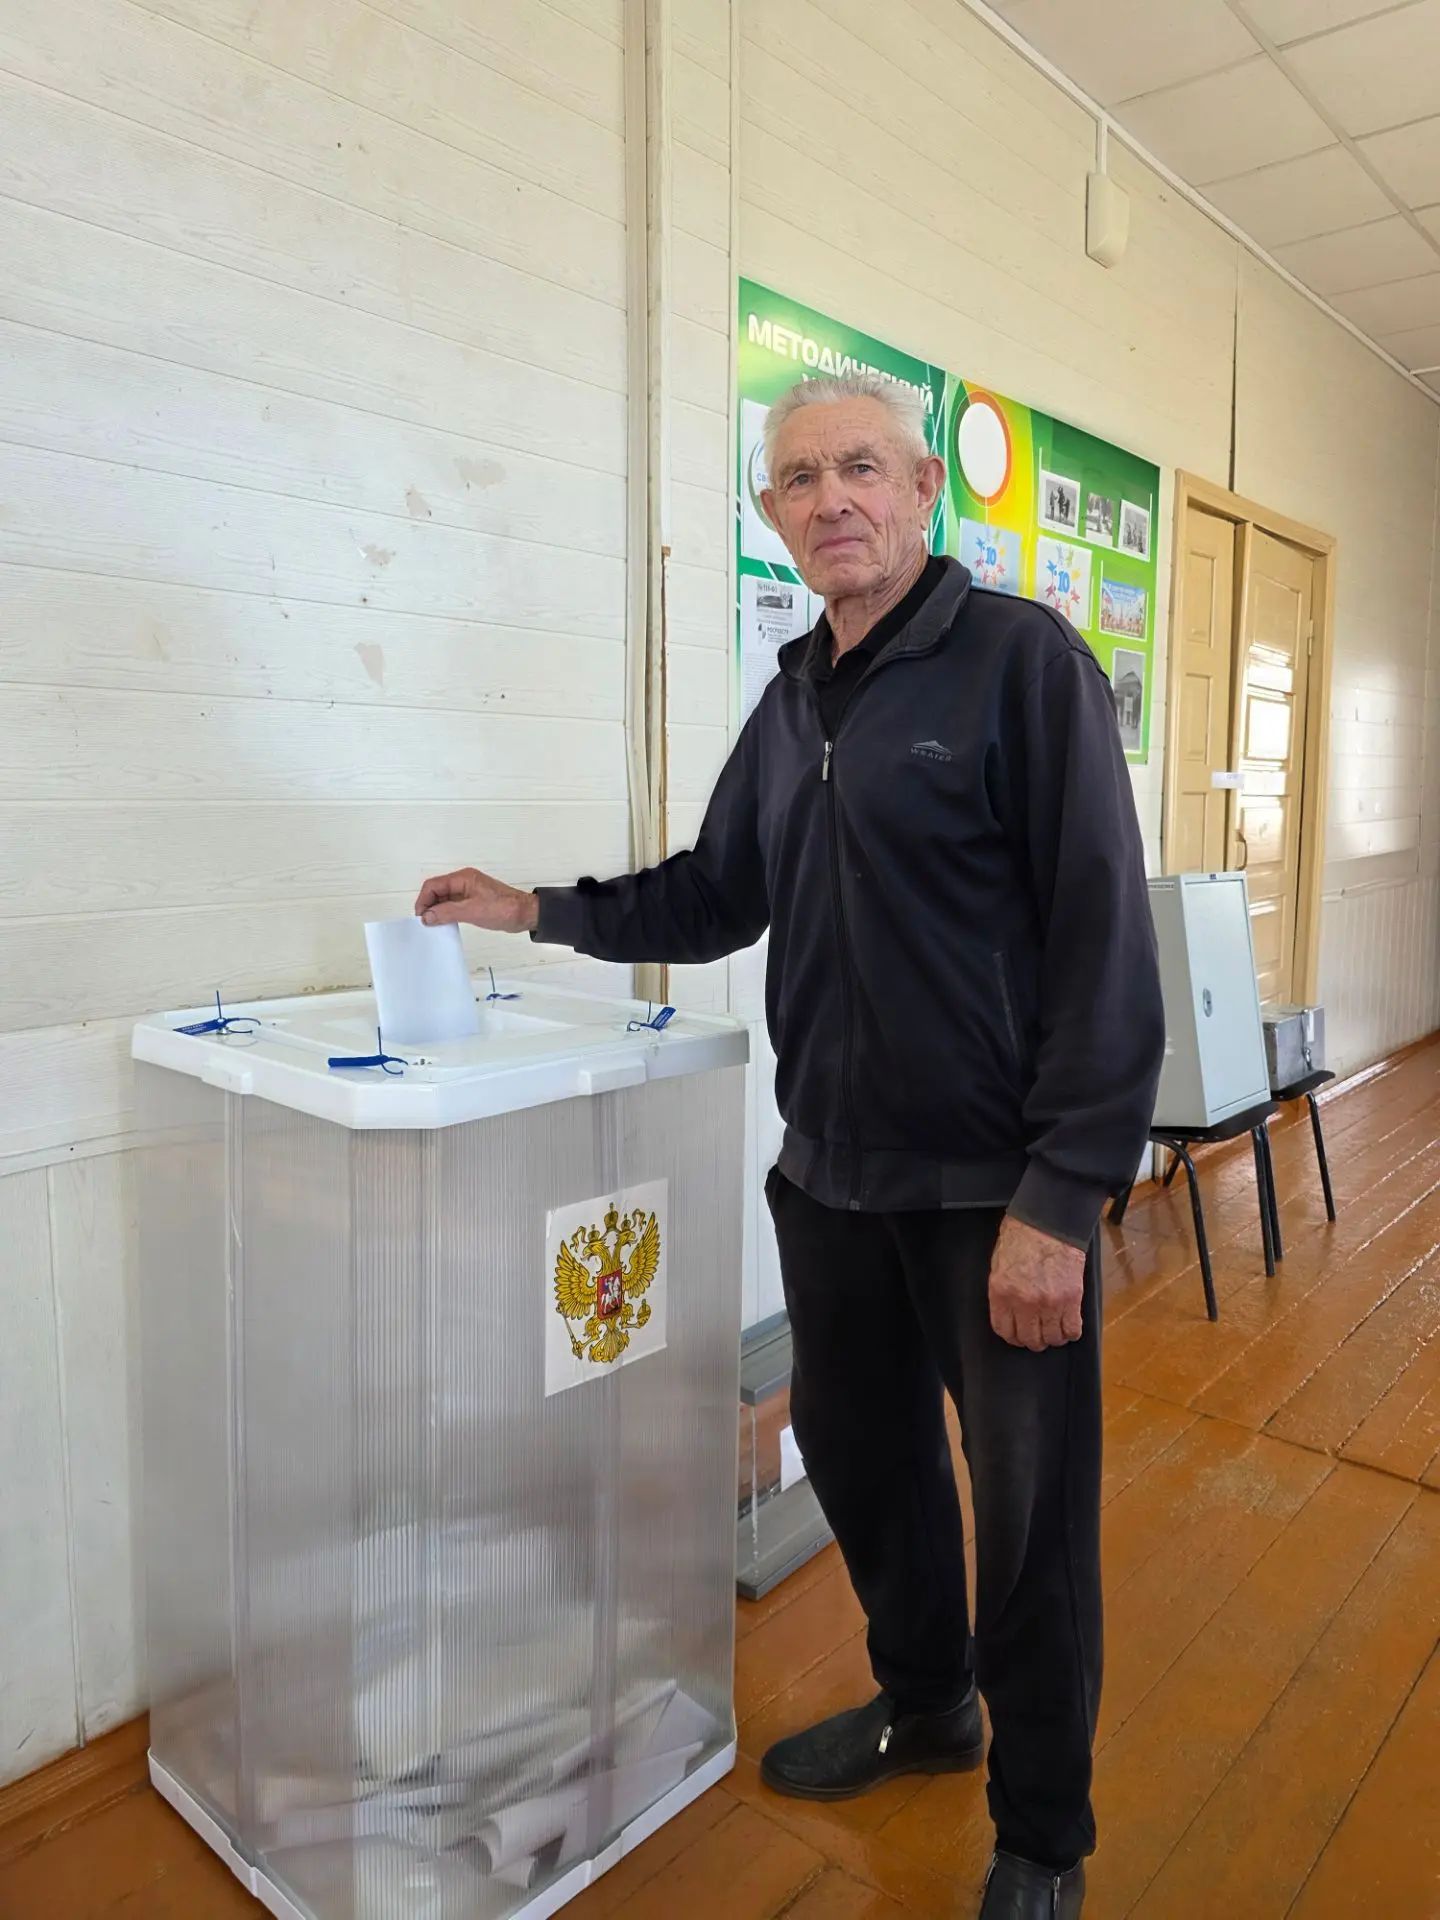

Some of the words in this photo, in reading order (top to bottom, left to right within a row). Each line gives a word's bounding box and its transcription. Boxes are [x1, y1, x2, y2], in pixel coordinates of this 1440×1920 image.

[748, 314, 934, 415] МЕТОДИЧЙ
[986, 546, 997, 566] 10
[1058, 570, 1071, 593] 10
